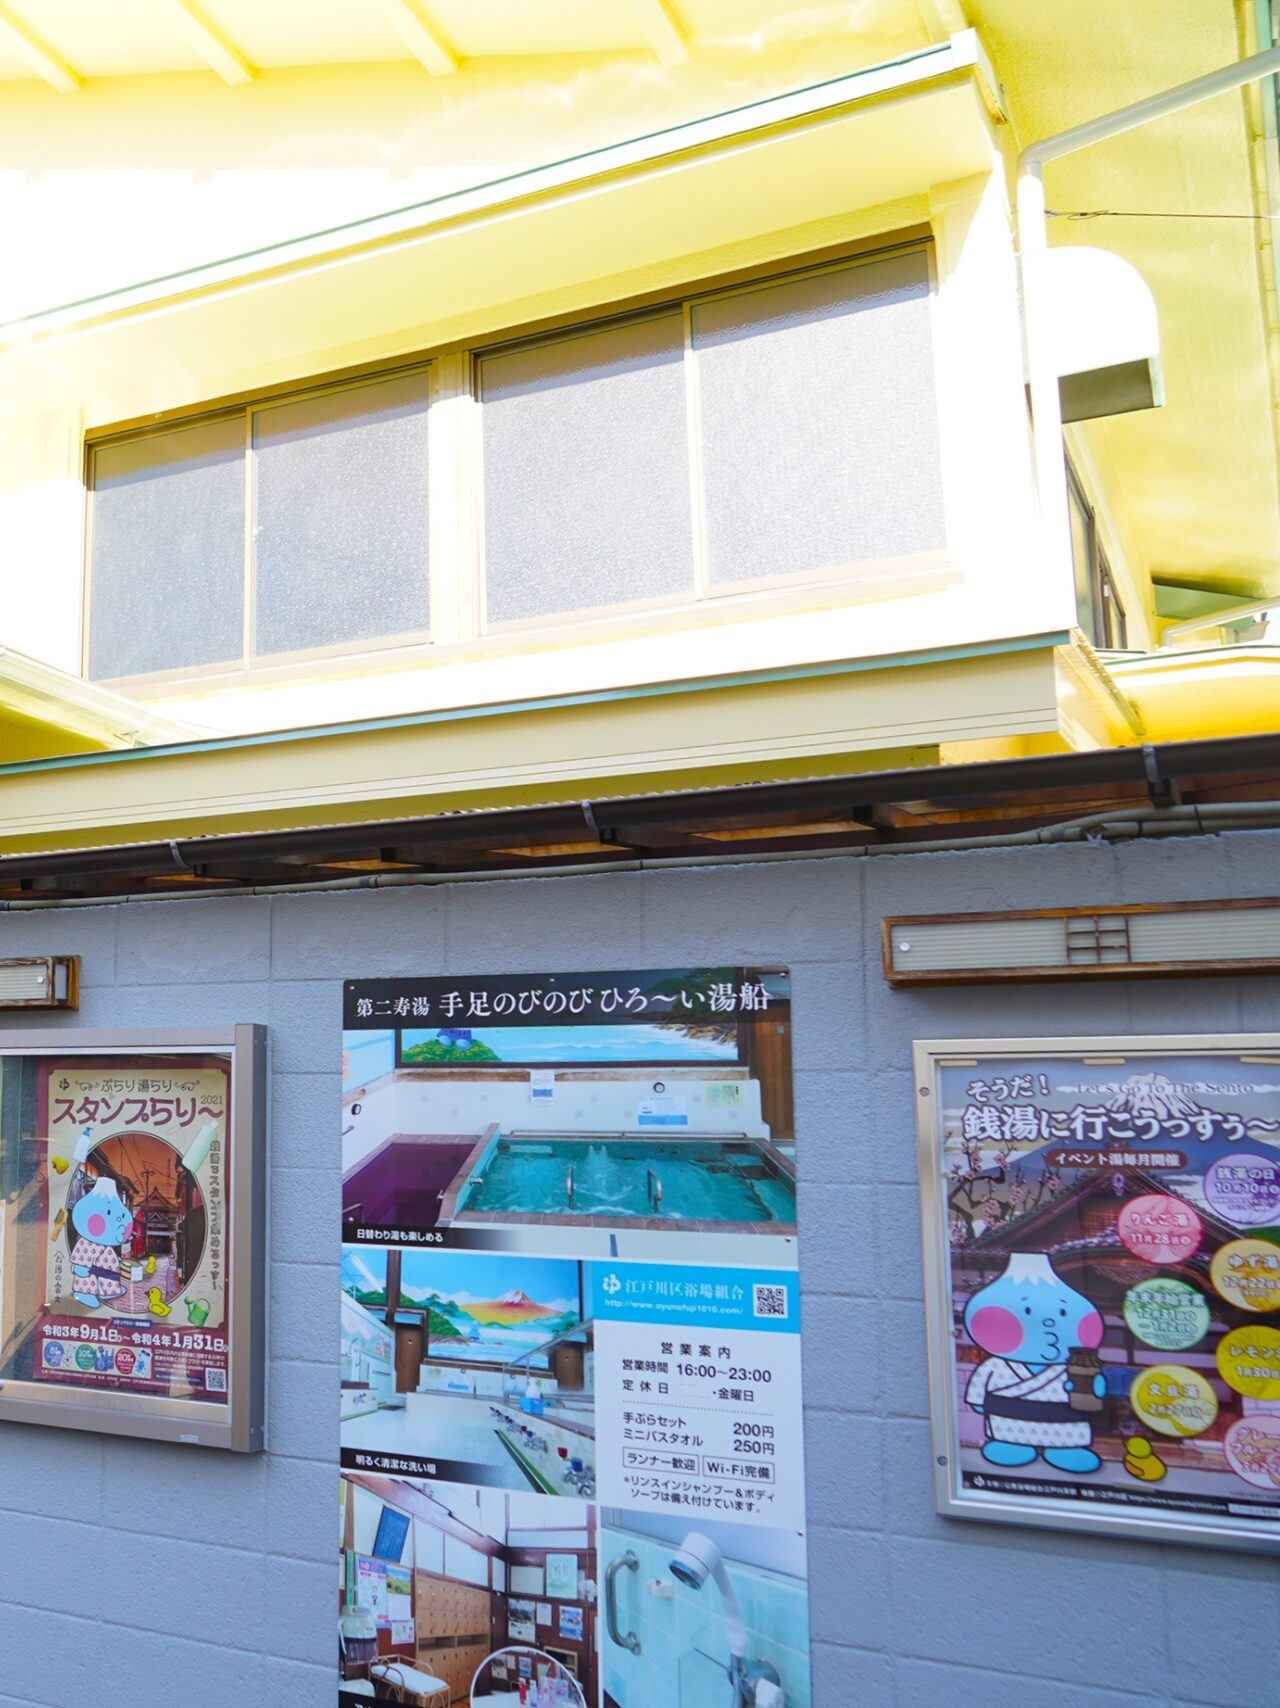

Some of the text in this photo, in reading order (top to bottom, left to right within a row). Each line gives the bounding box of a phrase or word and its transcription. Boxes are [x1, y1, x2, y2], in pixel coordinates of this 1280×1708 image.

[356, 996, 431, 1018] 第二寿湯
[439, 988, 595, 1018] 手足のびのび
[1055, 1152, 1181, 1167] イベント湯毎月開催
[356, 1228, 444, 1243] 日替わり湯も楽しめる
[625, 1279, 745, 1301] 江戸川区浴場組合
[661, 1342, 732, 1360] 営業案内
[621, 1359, 669, 1375] 営業時間
[621, 1379, 669, 1395] 定休日
[623, 1411, 775, 1439] 手ぶらセット 200円
[623, 1428, 775, 1456] ミニバスタオル 250円
[355, 1454, 437, 1475] 明るく清潔な洗い場
[627, 1453, 771, 1480] ランナー歓迎 Wi-Fi完備
[630, 1488, 761, 1513] ソープは備え付けています。
